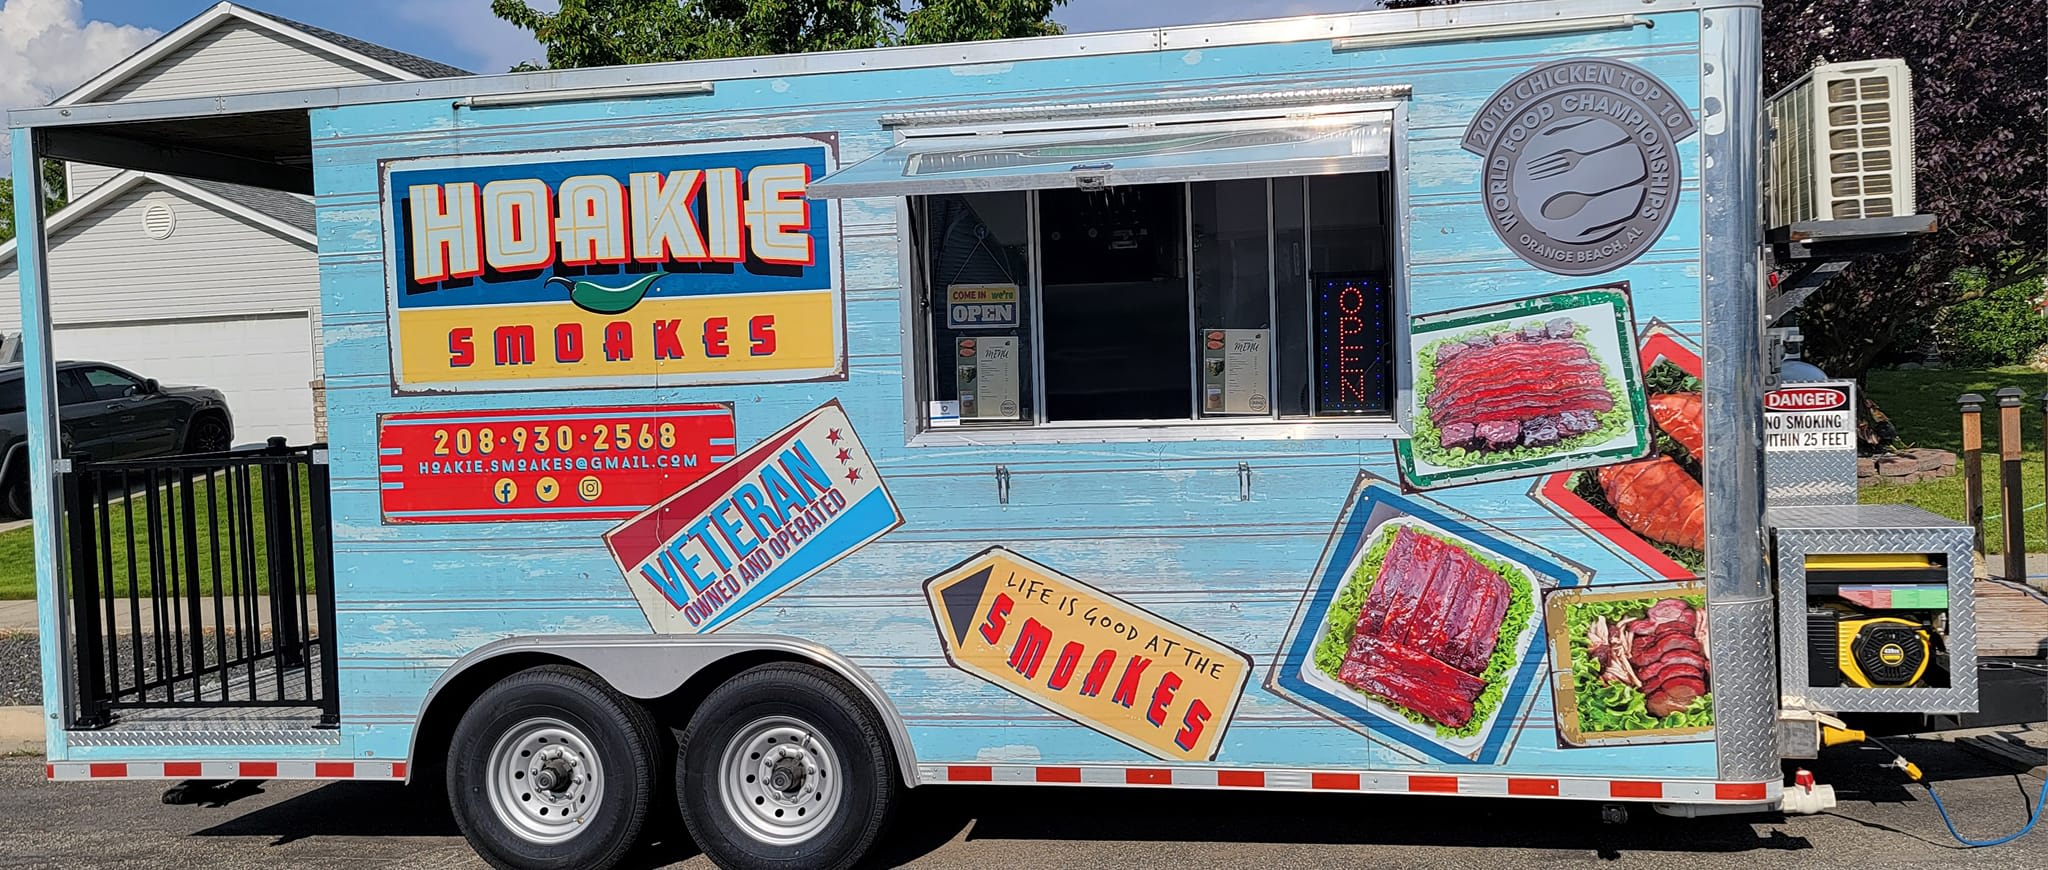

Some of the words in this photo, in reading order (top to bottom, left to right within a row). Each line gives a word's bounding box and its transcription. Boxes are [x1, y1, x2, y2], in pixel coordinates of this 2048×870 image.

[1472, 95, 1515, 146] 2018
[1515, 63, 1615, 102] CHICKEN
[1621, 70, 1663, 102] TOP
[1656, 102, 1684, 129] 10
[1501, 102, 1556, 152] FOOD
[1561, 93, 1670, 223] CHAMPIONSHIPS
[404, 162, 816, 293] HOAKIE
[1491, 155, 1520, 234] WORLD
[1519, 232, 1574, 263] ORANGE
[1577, 242, 1629, 263] BEACH,
[1626, 226, 1644, 245] AL
[952, 291, 976, 300] COME
[978, 291, 987, 299] IN
[952, 303, 1013, 322] OPEN
[448, 314, 778, 368] SMOAKES
[1339, 287, 1364, 402] OPEN
[1768, 392, 1838, 407] DANGER
[1786, 414, 1842, 429] SMOKING
[419, 454, 699, 475] HOAKIE.SMOAKES@GMAIL.COM
[1766, 433, 1800, 447] ITHIN
[1804, 433, 1818, 446] 25
[1822, 432, 1849, 446] FEET
[640, 438, 833, 613] VETERAN
[683, 571, 741, 628] OWNED
[737, 547, 773, 586] AND
[768, 487, 848, 560] OPERATED
[1006, 571, 1054, 605] LIFE
[1059, 596, 1079, 617] IS
[1083, 607, 1139, 641] GOOD
[1145, 634, 1181, 658] AT
[1183, 648, 1225, 681] THE
[978, 592, 1213, 753] SMOAKES
